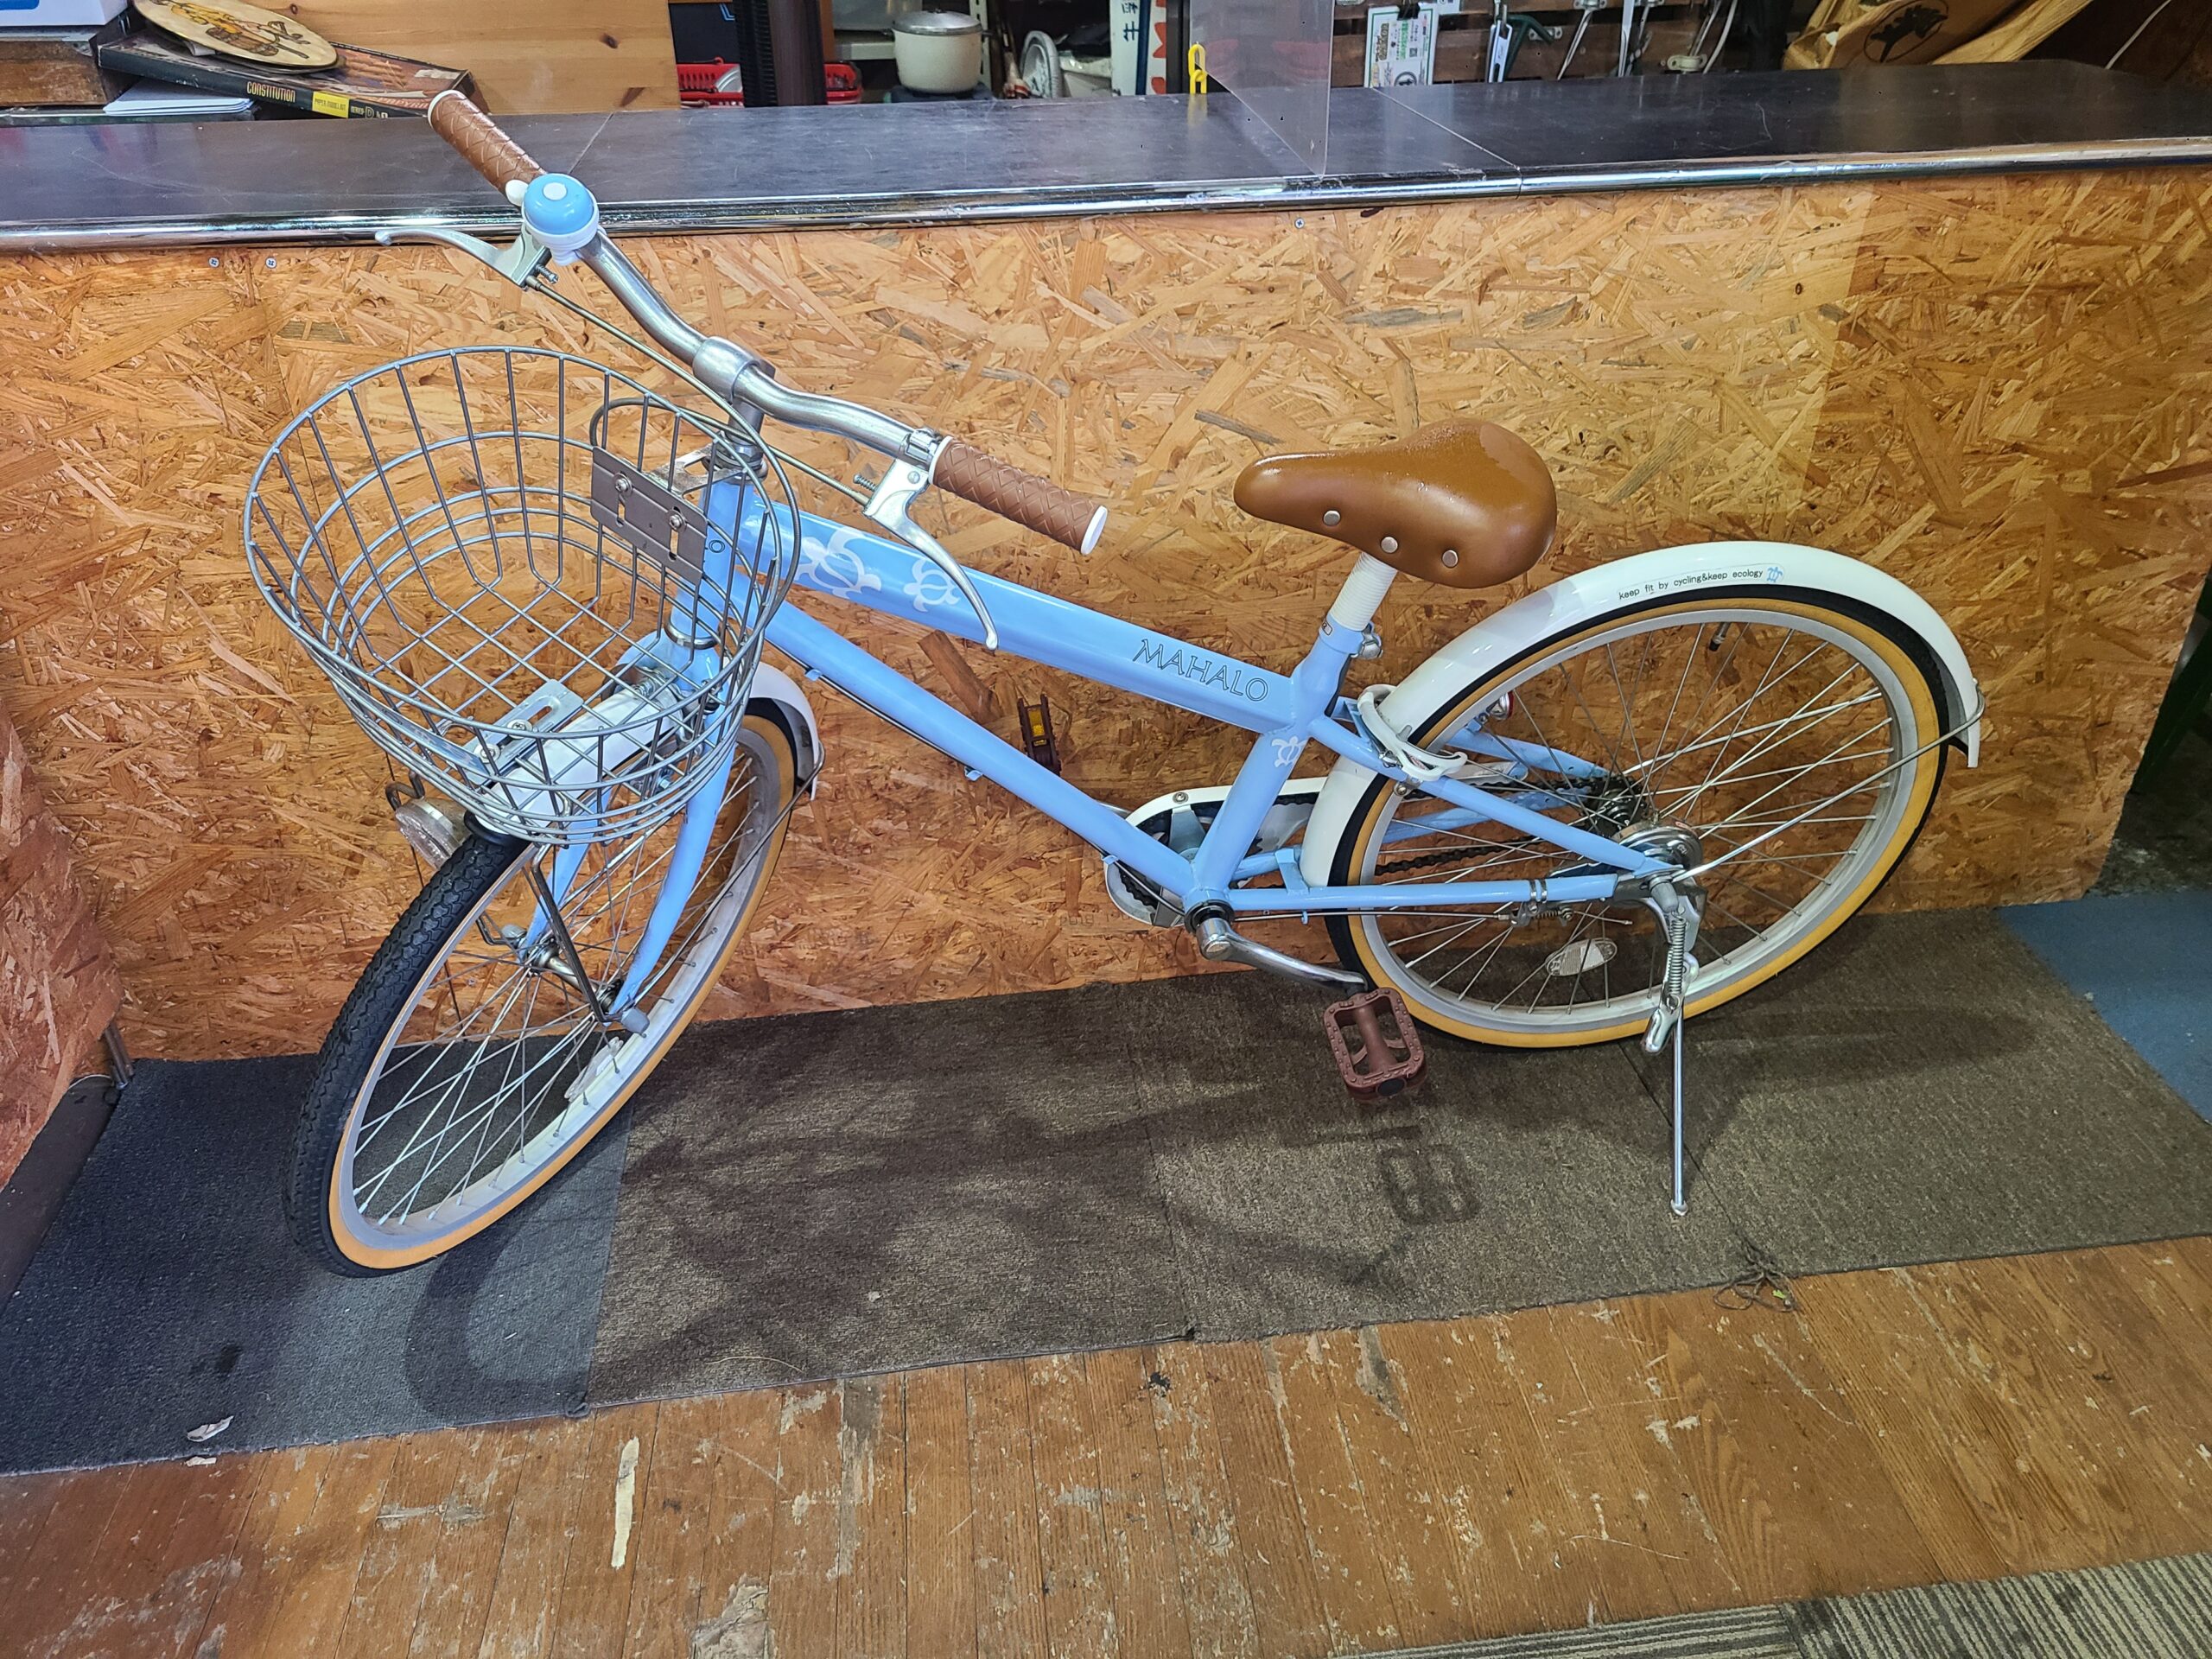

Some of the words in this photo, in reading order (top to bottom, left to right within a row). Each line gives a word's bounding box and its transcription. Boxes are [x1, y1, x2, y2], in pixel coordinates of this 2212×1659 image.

[246, 80, 296, 103] CONSTITUTION
[1618, 588, 1640, 600] keep
[1645, 584, 1654, 593] fit
[1658, 582, 1669, 590] by
[1674, 572, 1728, 587] cycling&keep
[1732, 569, 1763, 579] ecology
[1133, 639, 1268, 702] MAHALO
